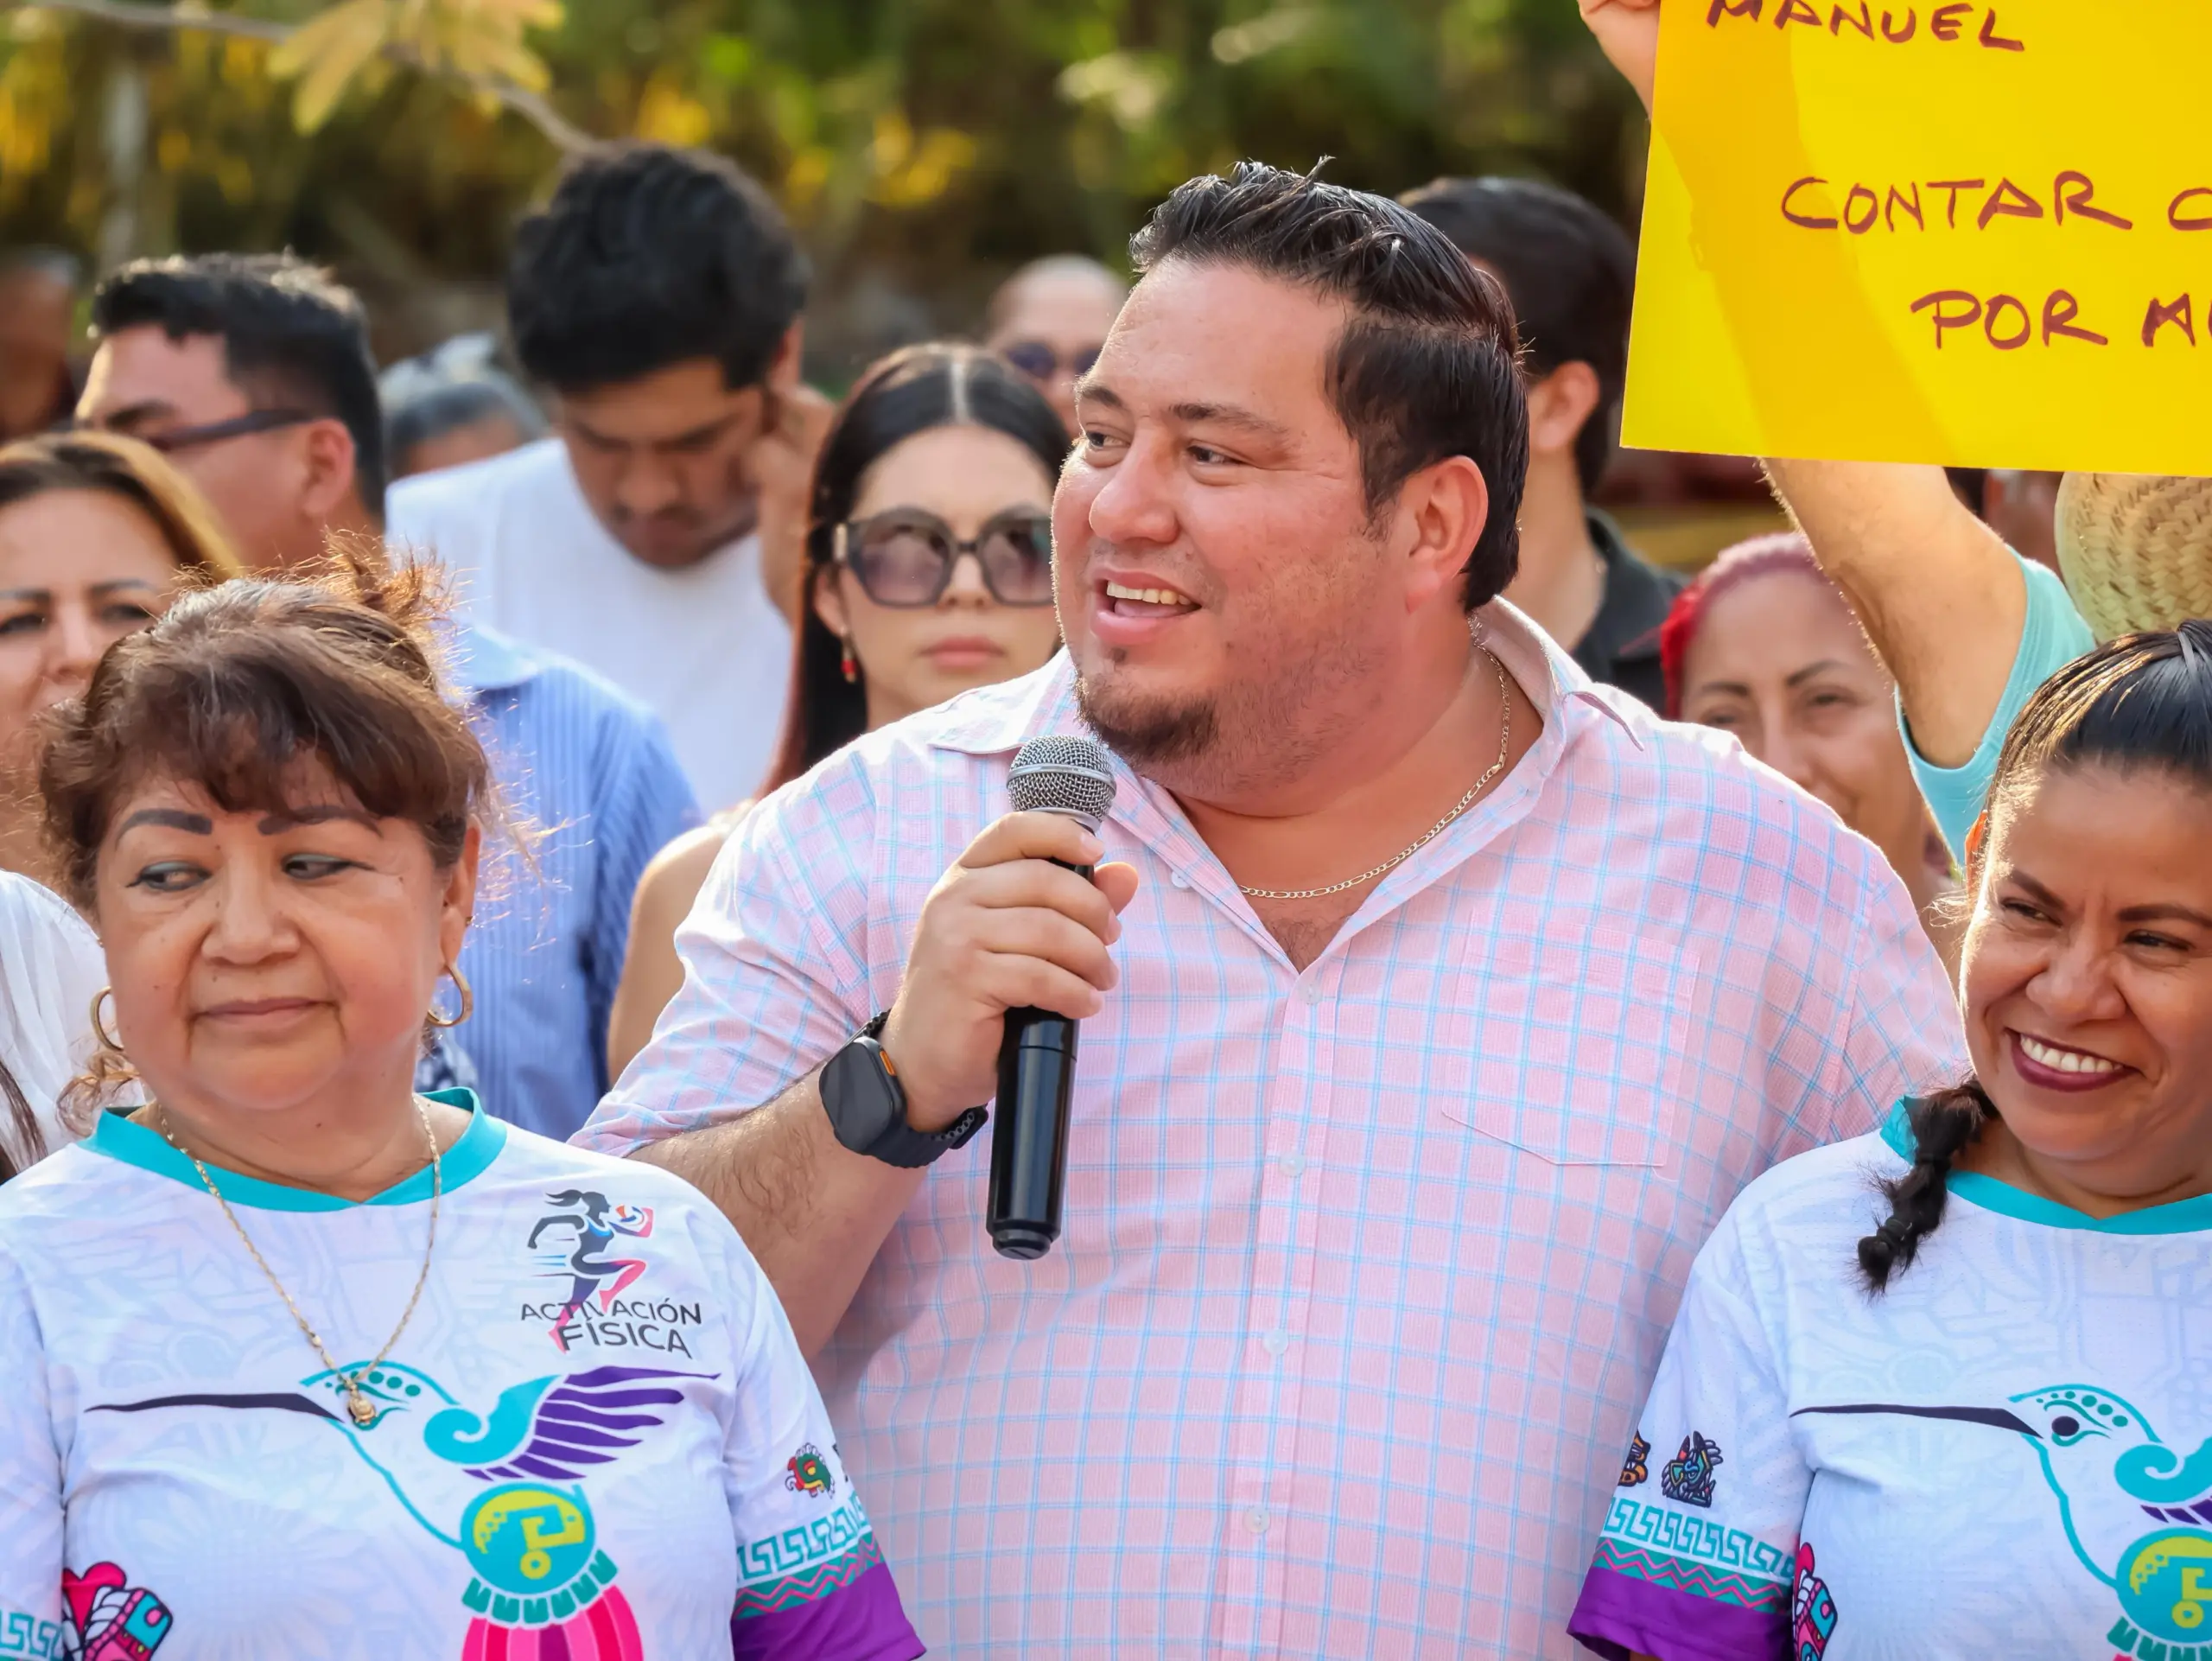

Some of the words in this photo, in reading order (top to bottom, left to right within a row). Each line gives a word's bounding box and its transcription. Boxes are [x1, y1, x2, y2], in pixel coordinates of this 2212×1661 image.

[1706, 0, 2025, 52] MANUEL
[1780, 170, 2133, 235] CONTAR
[1910, 289, 2108, 350] POR
